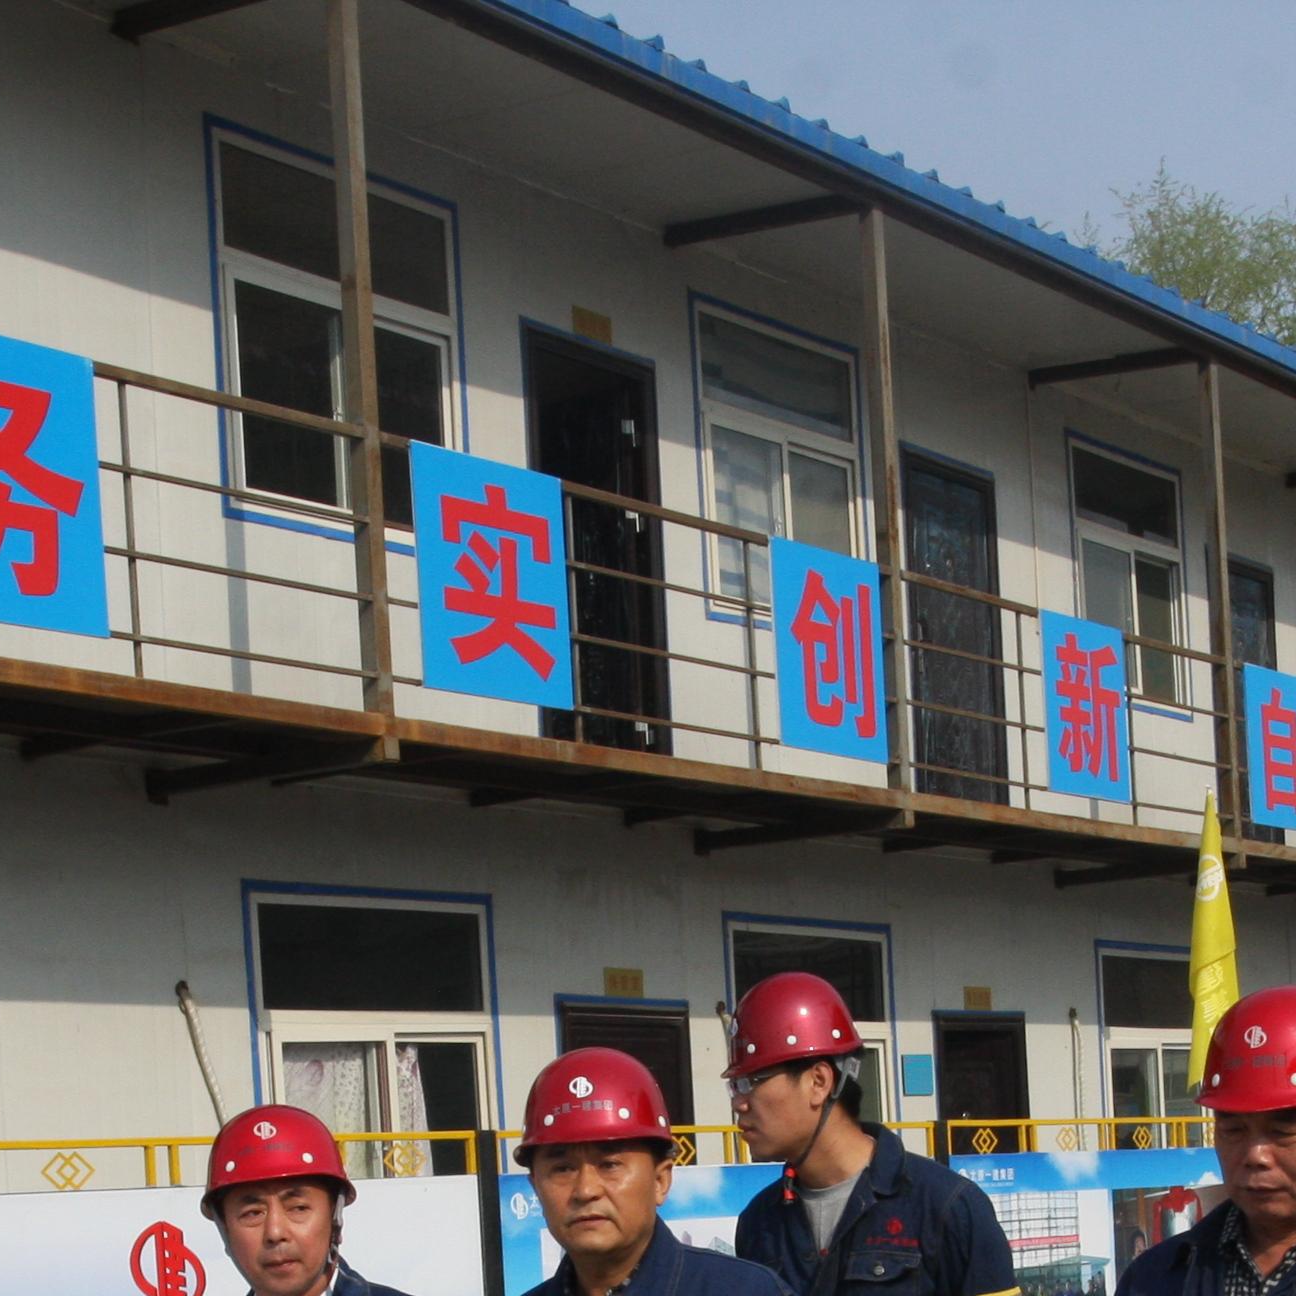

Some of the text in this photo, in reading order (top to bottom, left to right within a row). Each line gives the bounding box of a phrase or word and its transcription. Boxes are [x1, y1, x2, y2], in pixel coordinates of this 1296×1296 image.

[439, 484, 557, 682] 实
[790, 568, 877, 738] 创
[1054, 632, 1122, 783] 新
